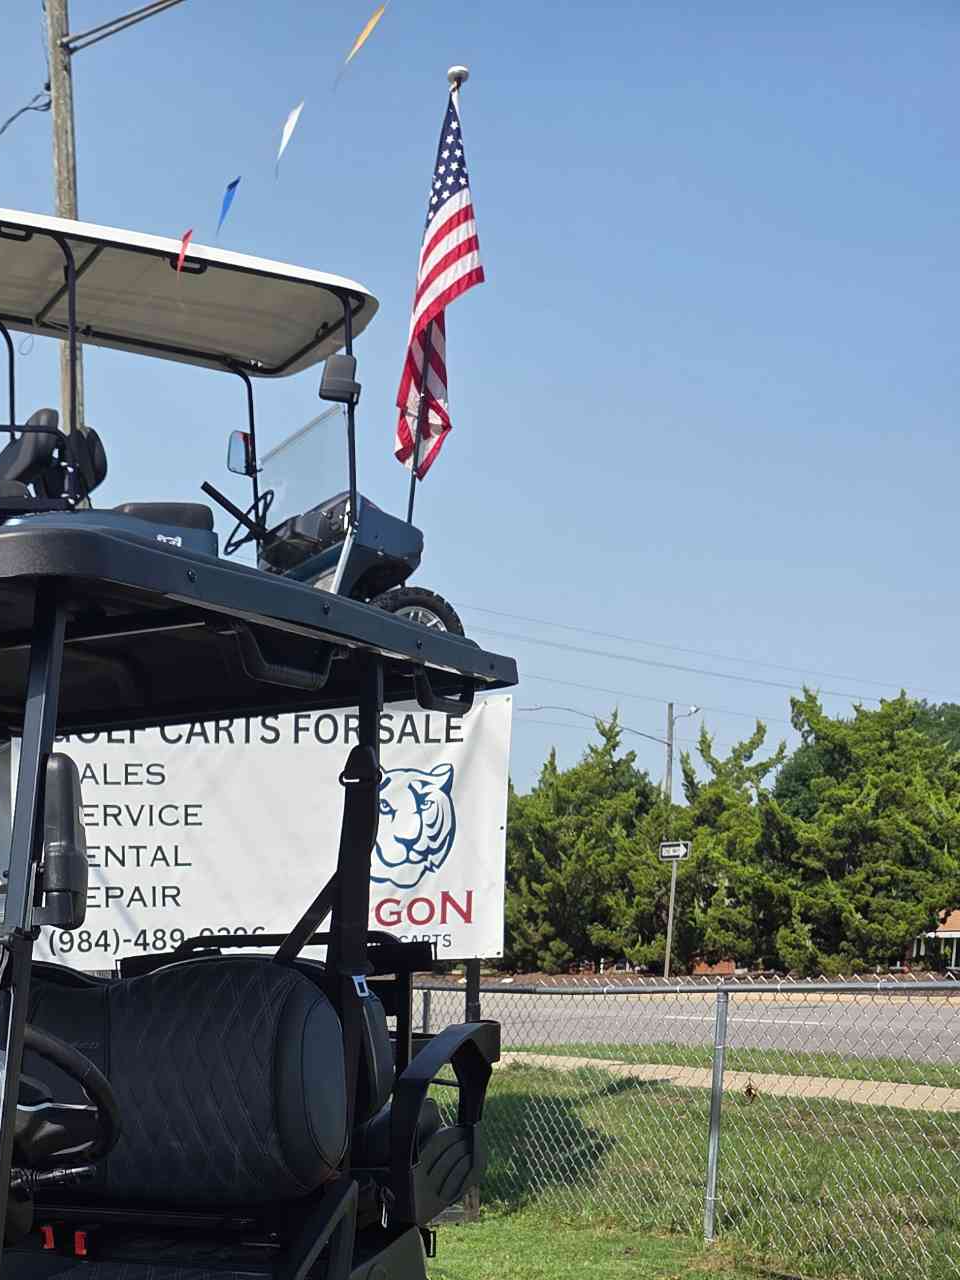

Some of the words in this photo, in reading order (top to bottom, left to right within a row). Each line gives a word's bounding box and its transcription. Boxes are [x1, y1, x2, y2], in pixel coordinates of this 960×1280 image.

[293, 713, 360, 744] FOR
[378, 713, 464, 744] SALE
[80, 763, 166, 786] ALES
[82, 804, 203, 827] ERVICE
[86, 845, 193, 868] ENTAL
[86, 886, 182, 908] EPAIR
[374, 889, 473, 927] GON
